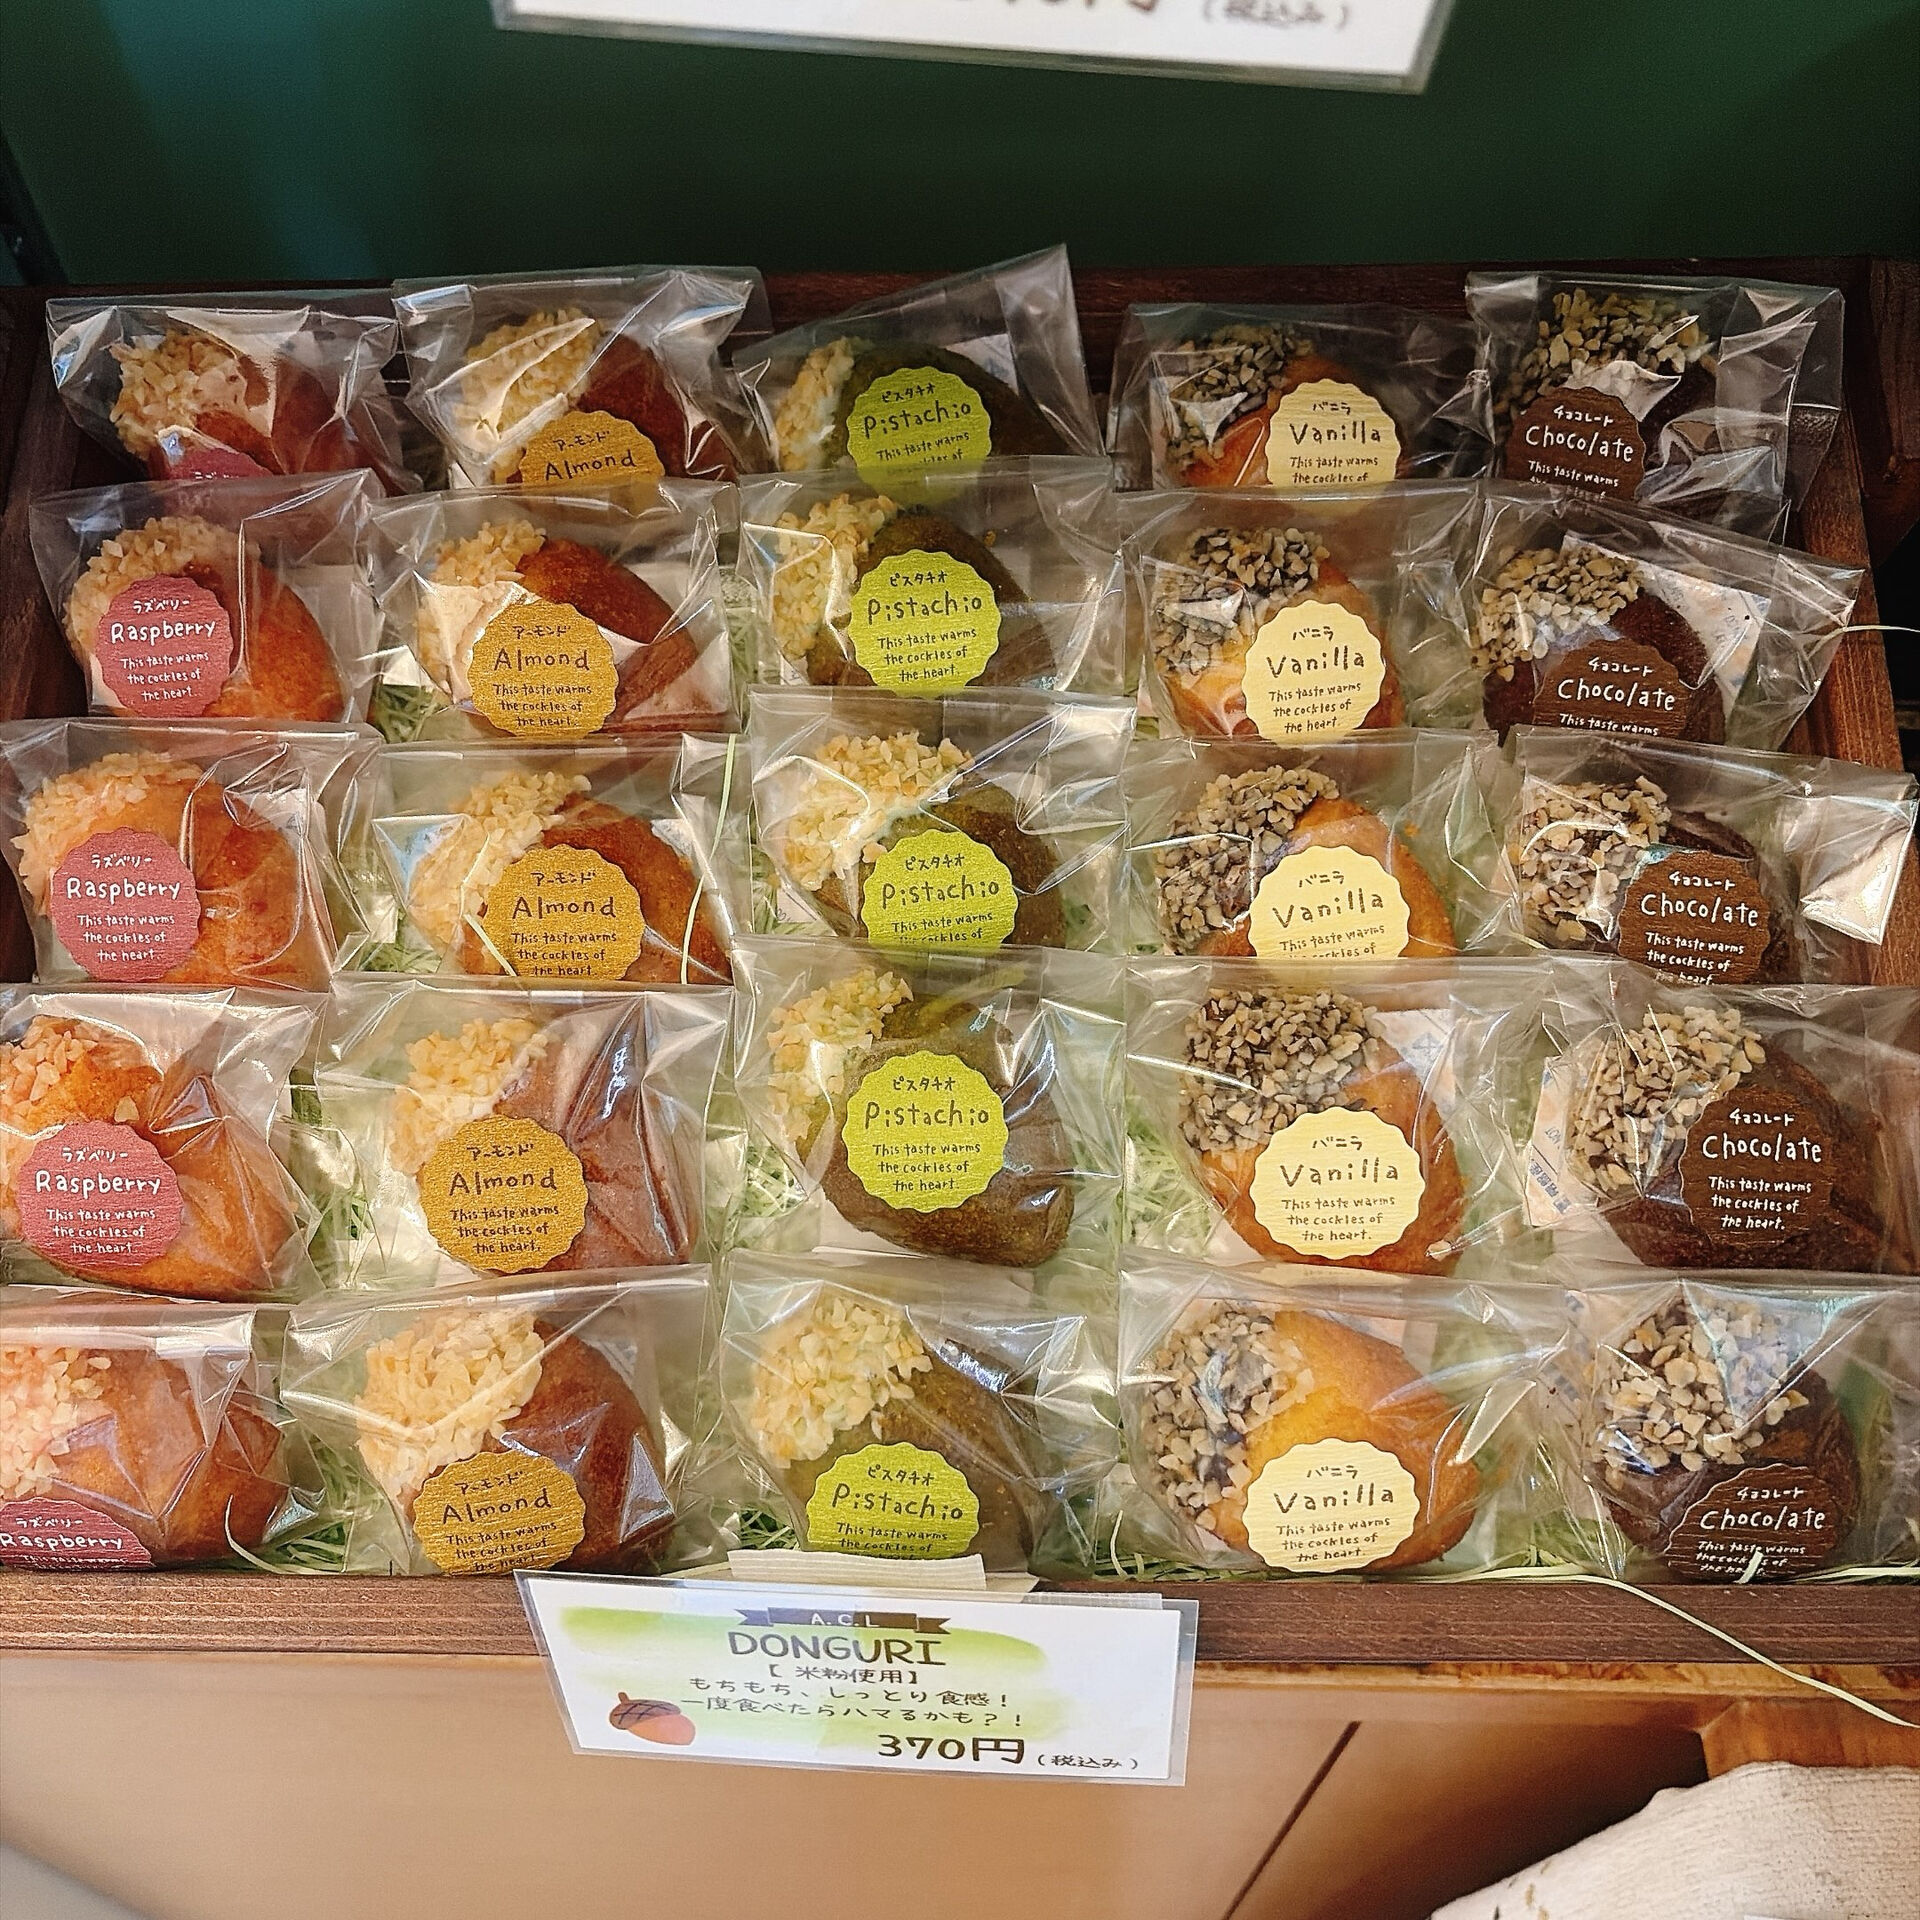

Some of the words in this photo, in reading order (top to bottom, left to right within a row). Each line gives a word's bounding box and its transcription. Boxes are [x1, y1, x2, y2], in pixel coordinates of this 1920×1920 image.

[1289, 420, 1381, 445] Vanilla
[1525, 425, 1633, 462] Chocolate
[545, 449, 637, 480] Almond
[1290, 456, 1312, 468] This
[1316, 456, 1343, 468] taste
[1528, 460, 1550, 473] This
[1554, 465, 1580, 481] taste
[1584, 473, 1619, 487] warms
[111, 620, 216, 646] Raspberry
[878, 638, 903, 649] This
[906, 633, 936, 646] taste
[941, 629, 976, 641] warms
[121, 659, 143, 670] This
[146, 655, 173, 667] taste
[176, 652, 209, 663] warms
[494, 648, 590, 671] Almond
[885, 654, 903, 664] the
[907, 650, 951, 663] cockles
[956, 646, 967, 658] of
[1267, 646, 1365, 678] Vanilla
[128, 674, 144, 684] the
[148, 671, 188, 684] cockles
[191, 668, 201, 679] of
[493, 684, 518, 695] This
[522, 684, 551, 695] taste
[555, 684, 591, 694] warms
[1269, 690, 1292, 702] This
[1296, 686, 1324, 699] taste
[1327, 683, 1361, 695] warms
[1558, 678, 1675, 711] Chocolate
[1273, 707, 1290, 717] the
[1295, 703, 1336, 714] cockles
[1340, 699, 1351, 710] of
[1560, 713, 1584, 725] This
[1588, 717, 1618, 731] taste
[1622, 724, 1659, 736] warms
[66, 878, 180, 905] Raspberry
[513, 897, 616, 919] Almond
[1273, 888, 1383, 927] Vanilla
[1641, 893, 1758, 926] Chocolate
[77, 915, 101, 927] This
[105, 915, 134, 926] taste
[138, 916, 174, 925] warms
[892, 921, 917, 933] This
[923, 919, 951, 930] taste
[955, 913, 992, 925] warms
[84, 932, 101, 943] the
[106, 933, 150, 943] cockles
[154, 931, 166, 941] of
[512, 933, 538, 944] This
[544, 933, 573, 944] taste
[578, 933, 616, 942] warms
[1646, 932, 1670, 944] This
[1675, 936, 1704, 950] taste
[1708, 943, 1744, 954] warms
[1647, 950, 1666, 963] the
[1669, 955, 1713, 969] cockles
[1718, 961, 1731, 971] of
[872, 1144, 899, 1156] This
[904, 1144, 936, 1156] taste
[941, 1144, 980, 1153] warms
[1702, 1132, 1822, 1162] Chocolate
[878, 1161, 898, 1173] the
[903, 1163, 951, 1173] cockles
[957, 1161, 969, 1172] of
[1280, 1157, 1398, 1187] Vanilla
[35, 1170, 160, 1199] Raspberry
[450, 1168, 557, 1195] Almond
[893, 1180, 913, 1191] the
[1709, 1176, 1735, 1190] This
[1739, 1177, 1770, 1191] taste
[1774, 1183, 1812, 1193] warms
[1282, 1199, 1310, 1210] This
[1315, 1198, 1348, 1209] taste
[1354, 1197, 1395, 1206] warms
[1711, 1195, 1730, 1208] the
[1734, 1198, 1782, 1212] cockles
[1786, 1200, 1799, 1213] of
[46, 1209, 73, 1222] This
[78, 1209, 110, 1221] taste
[115, 1210, 155, 1219] warms
[450, 1209, 478, 1221] This
[482, 1207, 515, 1220] taste
[519, 1206, 559, 1217] warms
[1288, 1215, 1308, 1225] the
[1314, 1215, 1364, 1225] cockles
[1370, 1213, 1383, 1223] of
[1721, 1215, 1740, 1228] the
[53, 1226, 74, 1237] the
[79, 1227, 127, 1237] cockles
[132, 1226, 146, 1237] of
[458, 1227, 480, 1237] the
[483, 1226, 532, 1236] cockles
[537, 1222, 549, 1234] of
[1302, 1231, 1324, 1241] the
[473, 1243, 495, 1253] the
[442, 1488, 551, 1524] Almond
[1274, 1483, 1394, 1513] Vanilla
[1276, 1525, 1305, 1536] This
[1310, 1521, 1344, 1533] taste
[1349, 1518, 1390, 1529] warms
[1700, 1506, 1825, 1530] Chocolate
[447, 1536, 473, 1545] This
[479, 1530, 511, 1543] taste
[516, 1522, 556, 1536] warms
[837, 1522, 864, 1534] This
[869, 1526, 902, 1538] taste
[907, 1532, 948, 1540] warms
[0, 1533, 122, 1550] Raspberry
[727, 1631, 947, 1667] DONGURI
[877, 1733, 1026, 1765] 370円
